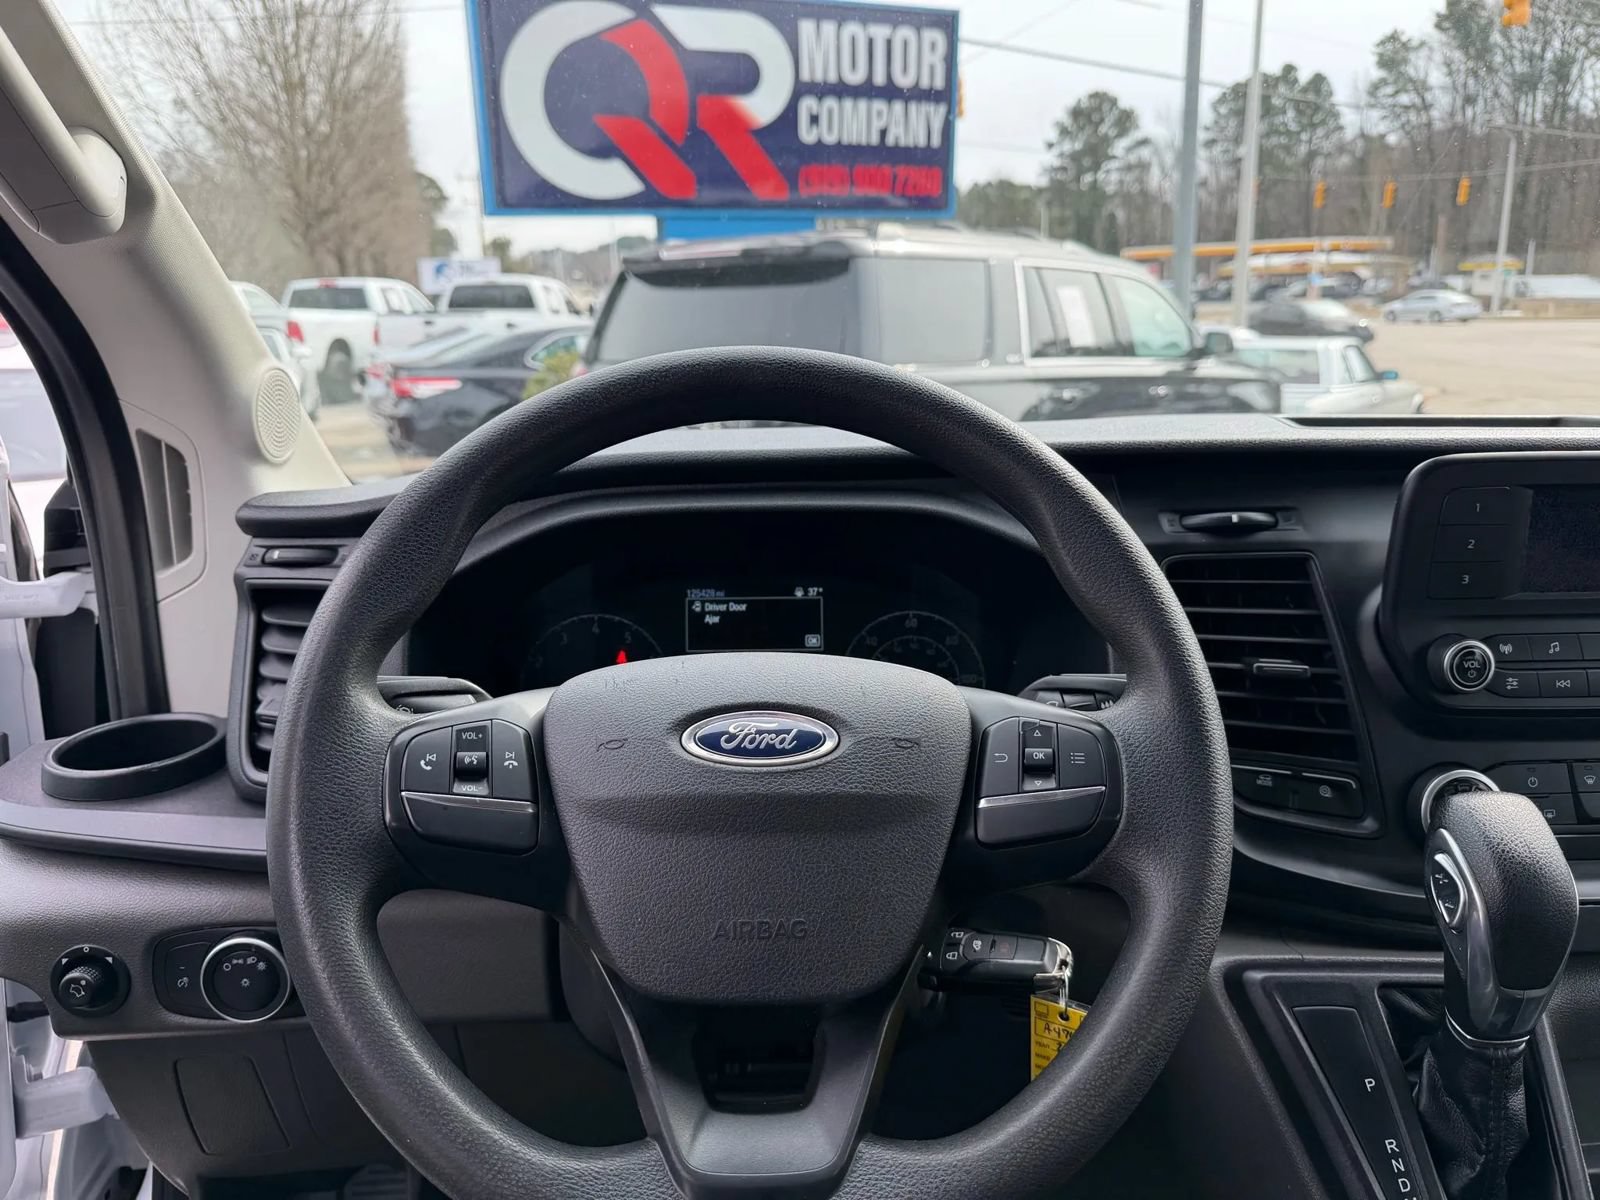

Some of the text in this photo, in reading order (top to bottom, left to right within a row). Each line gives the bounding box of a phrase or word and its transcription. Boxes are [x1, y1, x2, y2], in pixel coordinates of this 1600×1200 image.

[798, 17, 948, 91] MOTOR
[797, 94, 949, 149] COMPANY
[1475, 503, 1481, 512] 1
[1467, 539, 1475, 549] 2
[1461, 575, 1470, 584] 3
[704, 602, 747, 611] Driver Door
[704, 615, 720, 624] Ajar
[1463, 660, 1481, 669] VOL
[461, 731, 483, 740] VOL+
[720, 717, 799, 751] Ford
[1032, 751, 1045, 760] OK
[712, 918, 807, 940] AIRBAG
[1364, 1078, 1376, 1092] P
[1384, 1139, 1399, 1153] R
[1391, 1157, 1405, 1173] N
[1397, 1177, 1411, 1193] D
